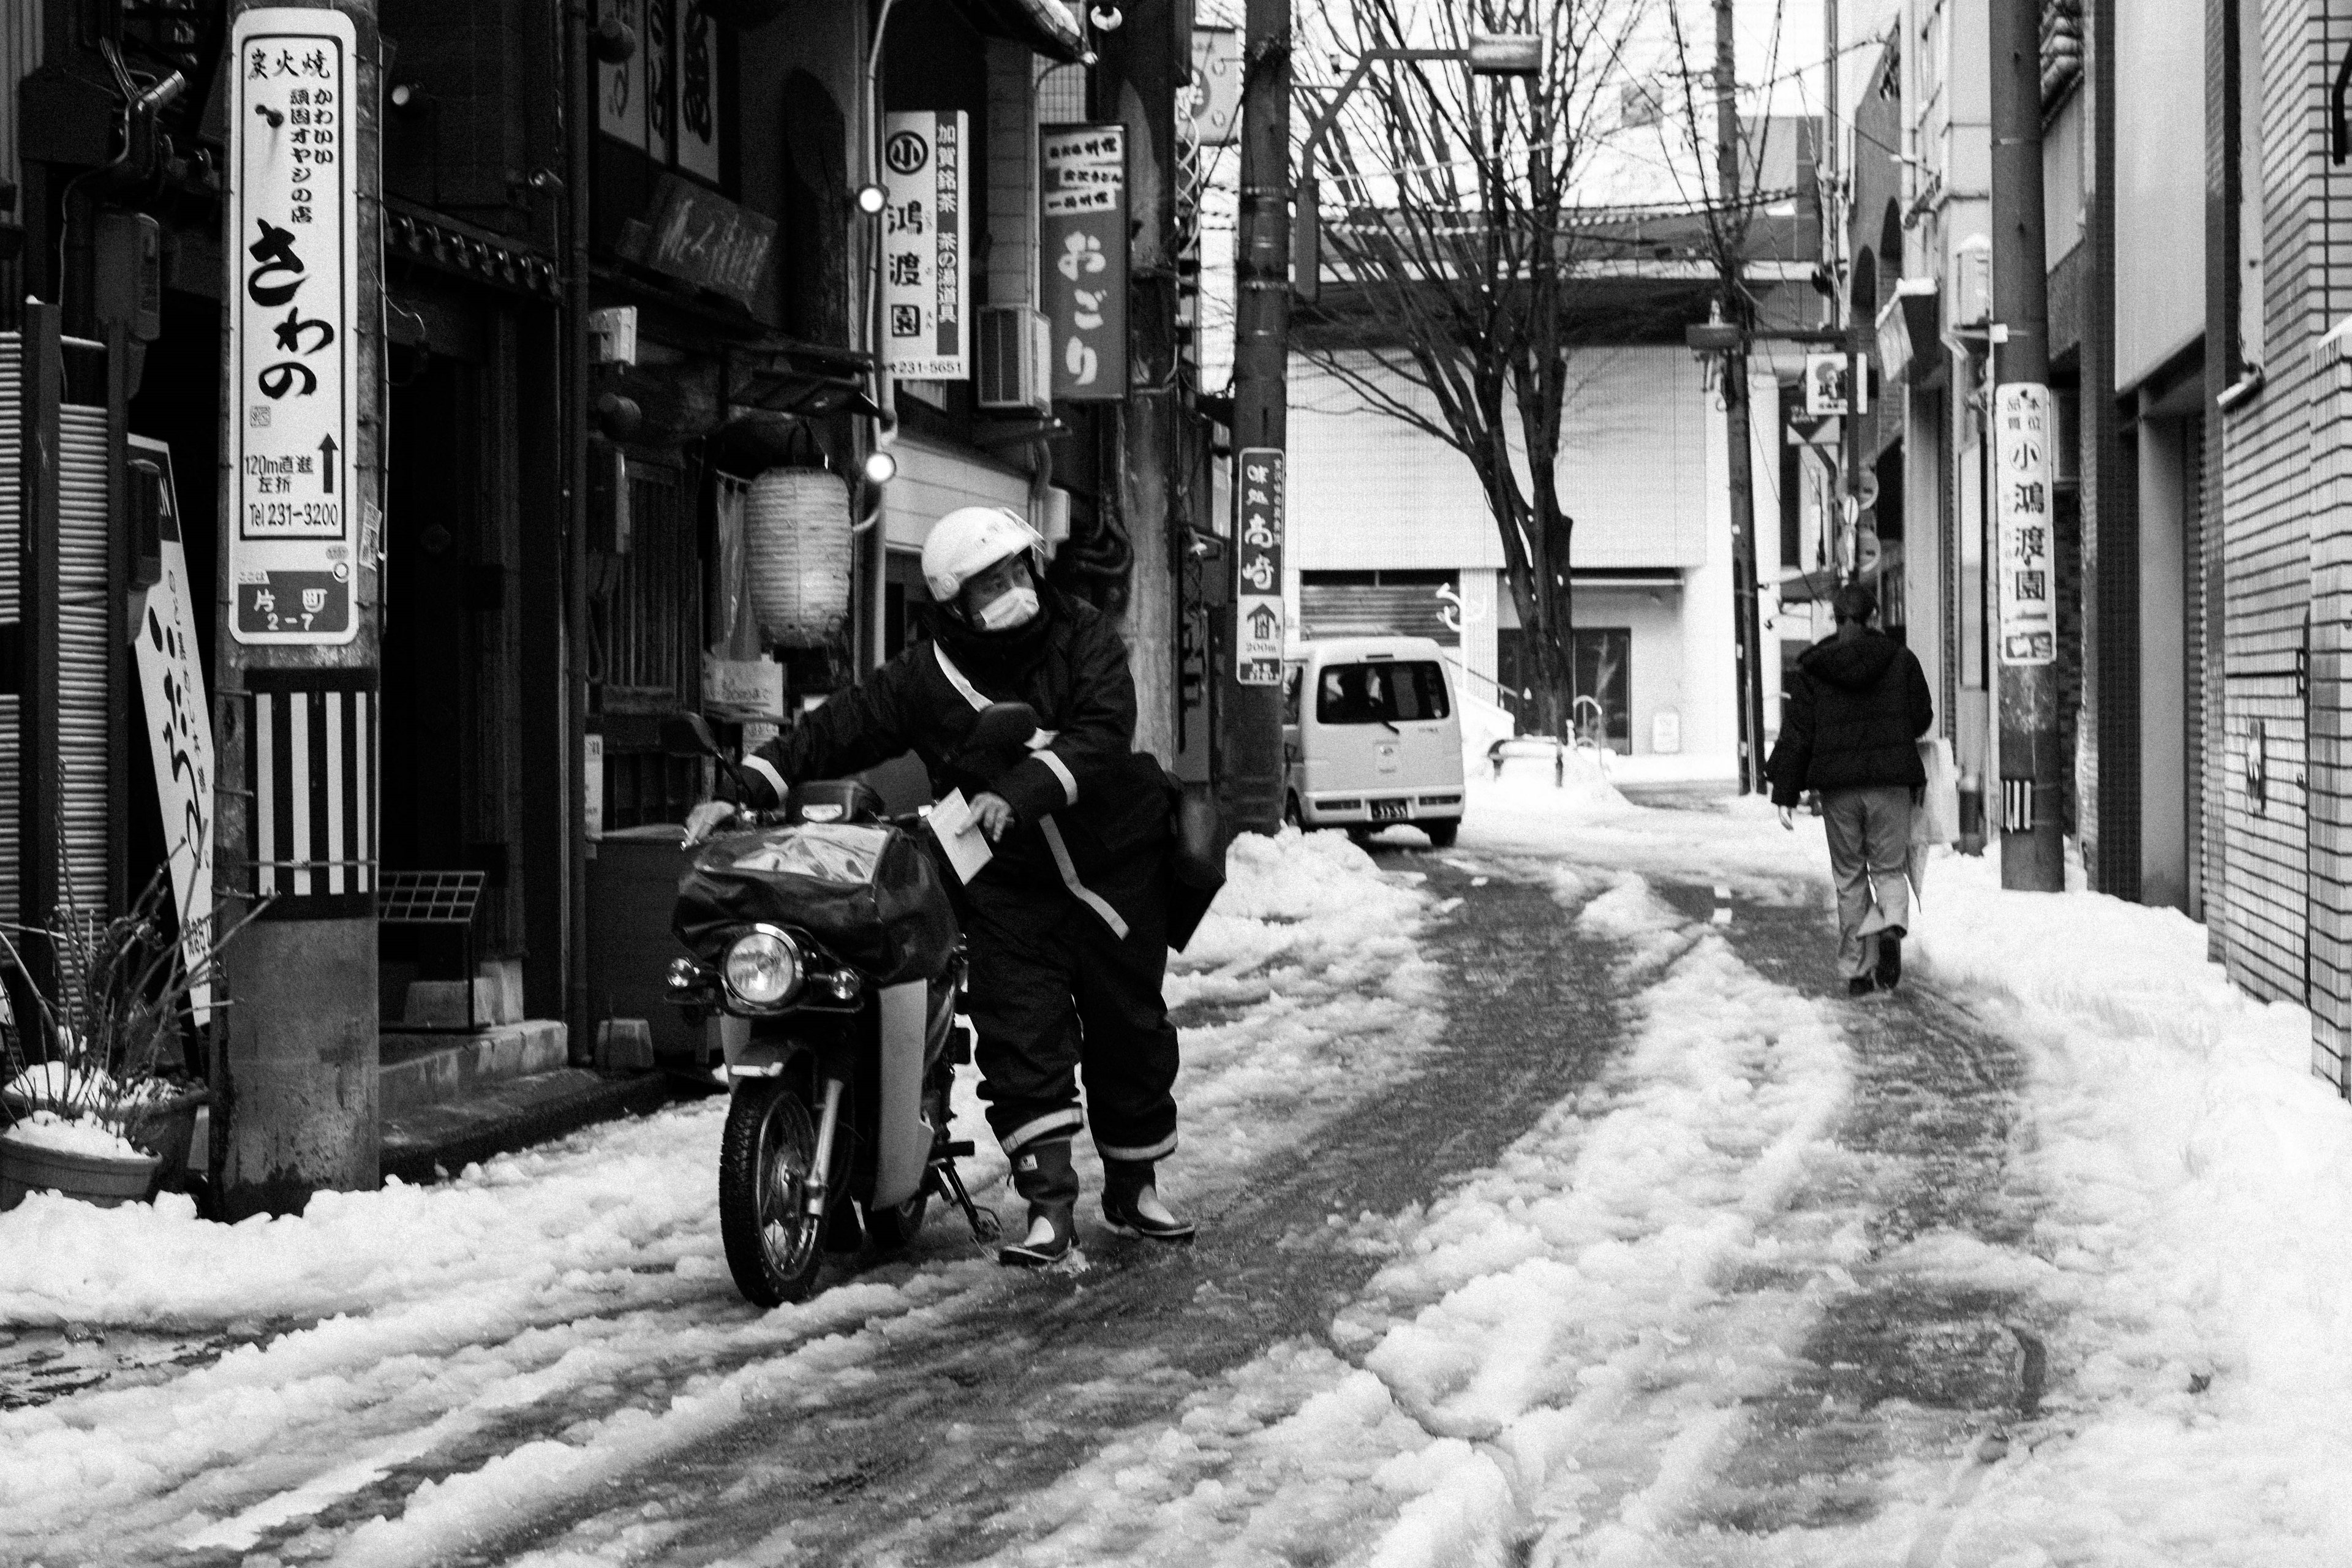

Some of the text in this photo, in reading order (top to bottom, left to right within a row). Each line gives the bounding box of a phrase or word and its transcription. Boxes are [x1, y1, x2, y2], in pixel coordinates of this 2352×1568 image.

[248, 48, 331, 80] 炭火焼
[313, 89, 334, 164] かわいい
[291, 88, 313, 224] 頑固オヤジの店
[937, 124, 957, 213] 加賀銘茶
[937, 232, 957, 323] 茶の湯道具
[248, 218, 334, 399] さわの
[245, 455, 314, 475] 120m直進
[258, 476, 291, 494] 左折
[249, 502, 338, 527] Tel 231-3200
[254, 588, 328, 612] 片町
[267, 614, 314, 631] 2-7
